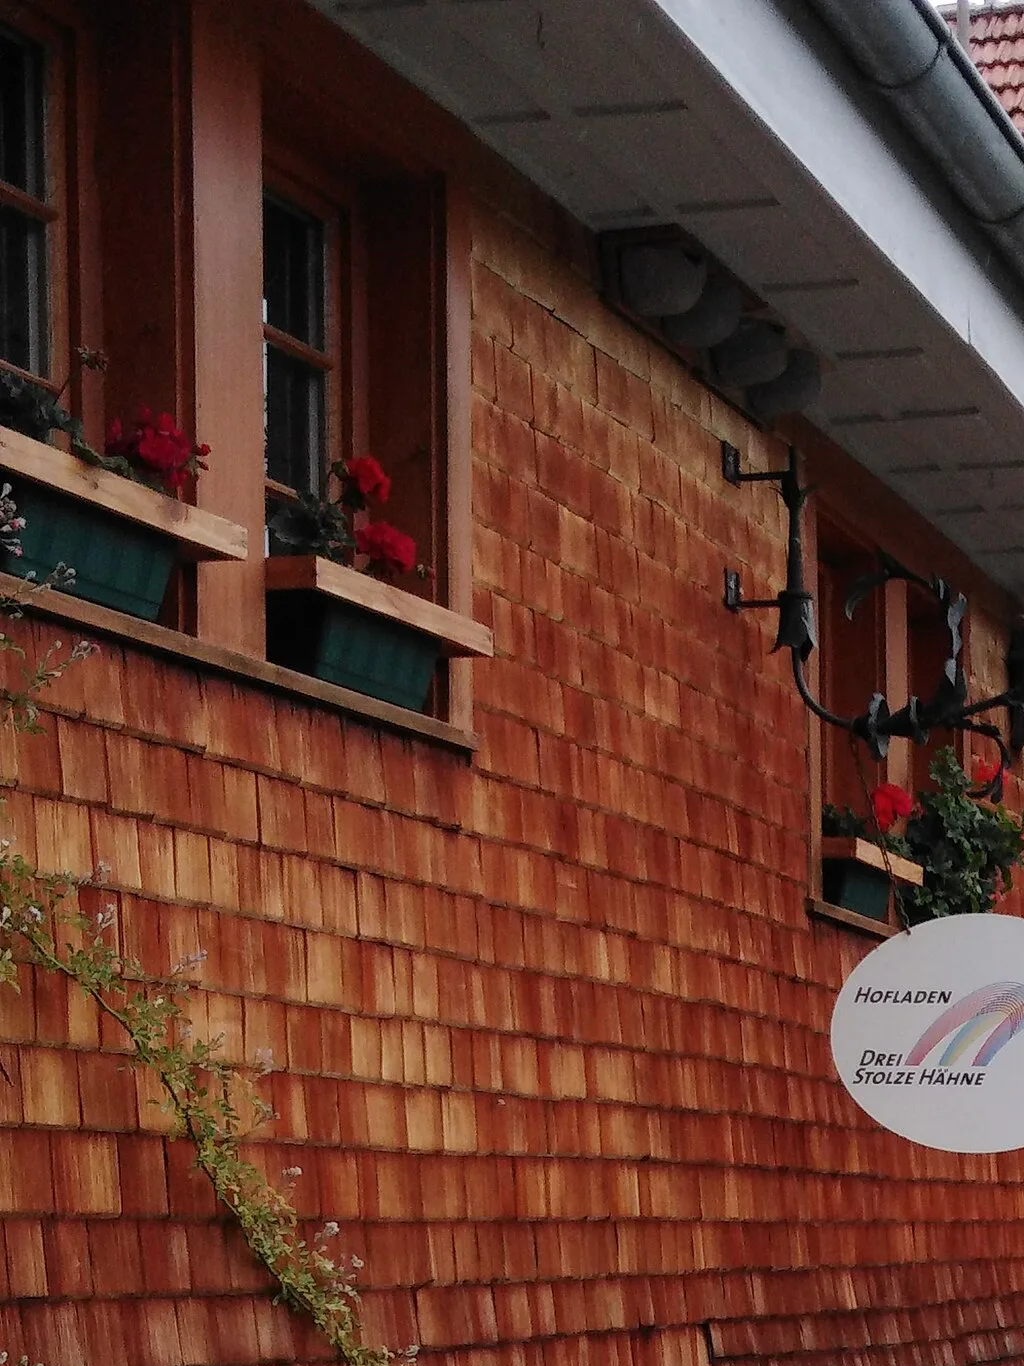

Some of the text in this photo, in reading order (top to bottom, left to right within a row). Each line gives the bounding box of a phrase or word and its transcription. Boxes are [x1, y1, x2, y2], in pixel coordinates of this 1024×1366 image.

[854, 986, 952, 1004] HOFLADEN
[860, 1049, 903, 1067] DREI
[853, 1067, 986, 1086] STOLZE HÄHNE
